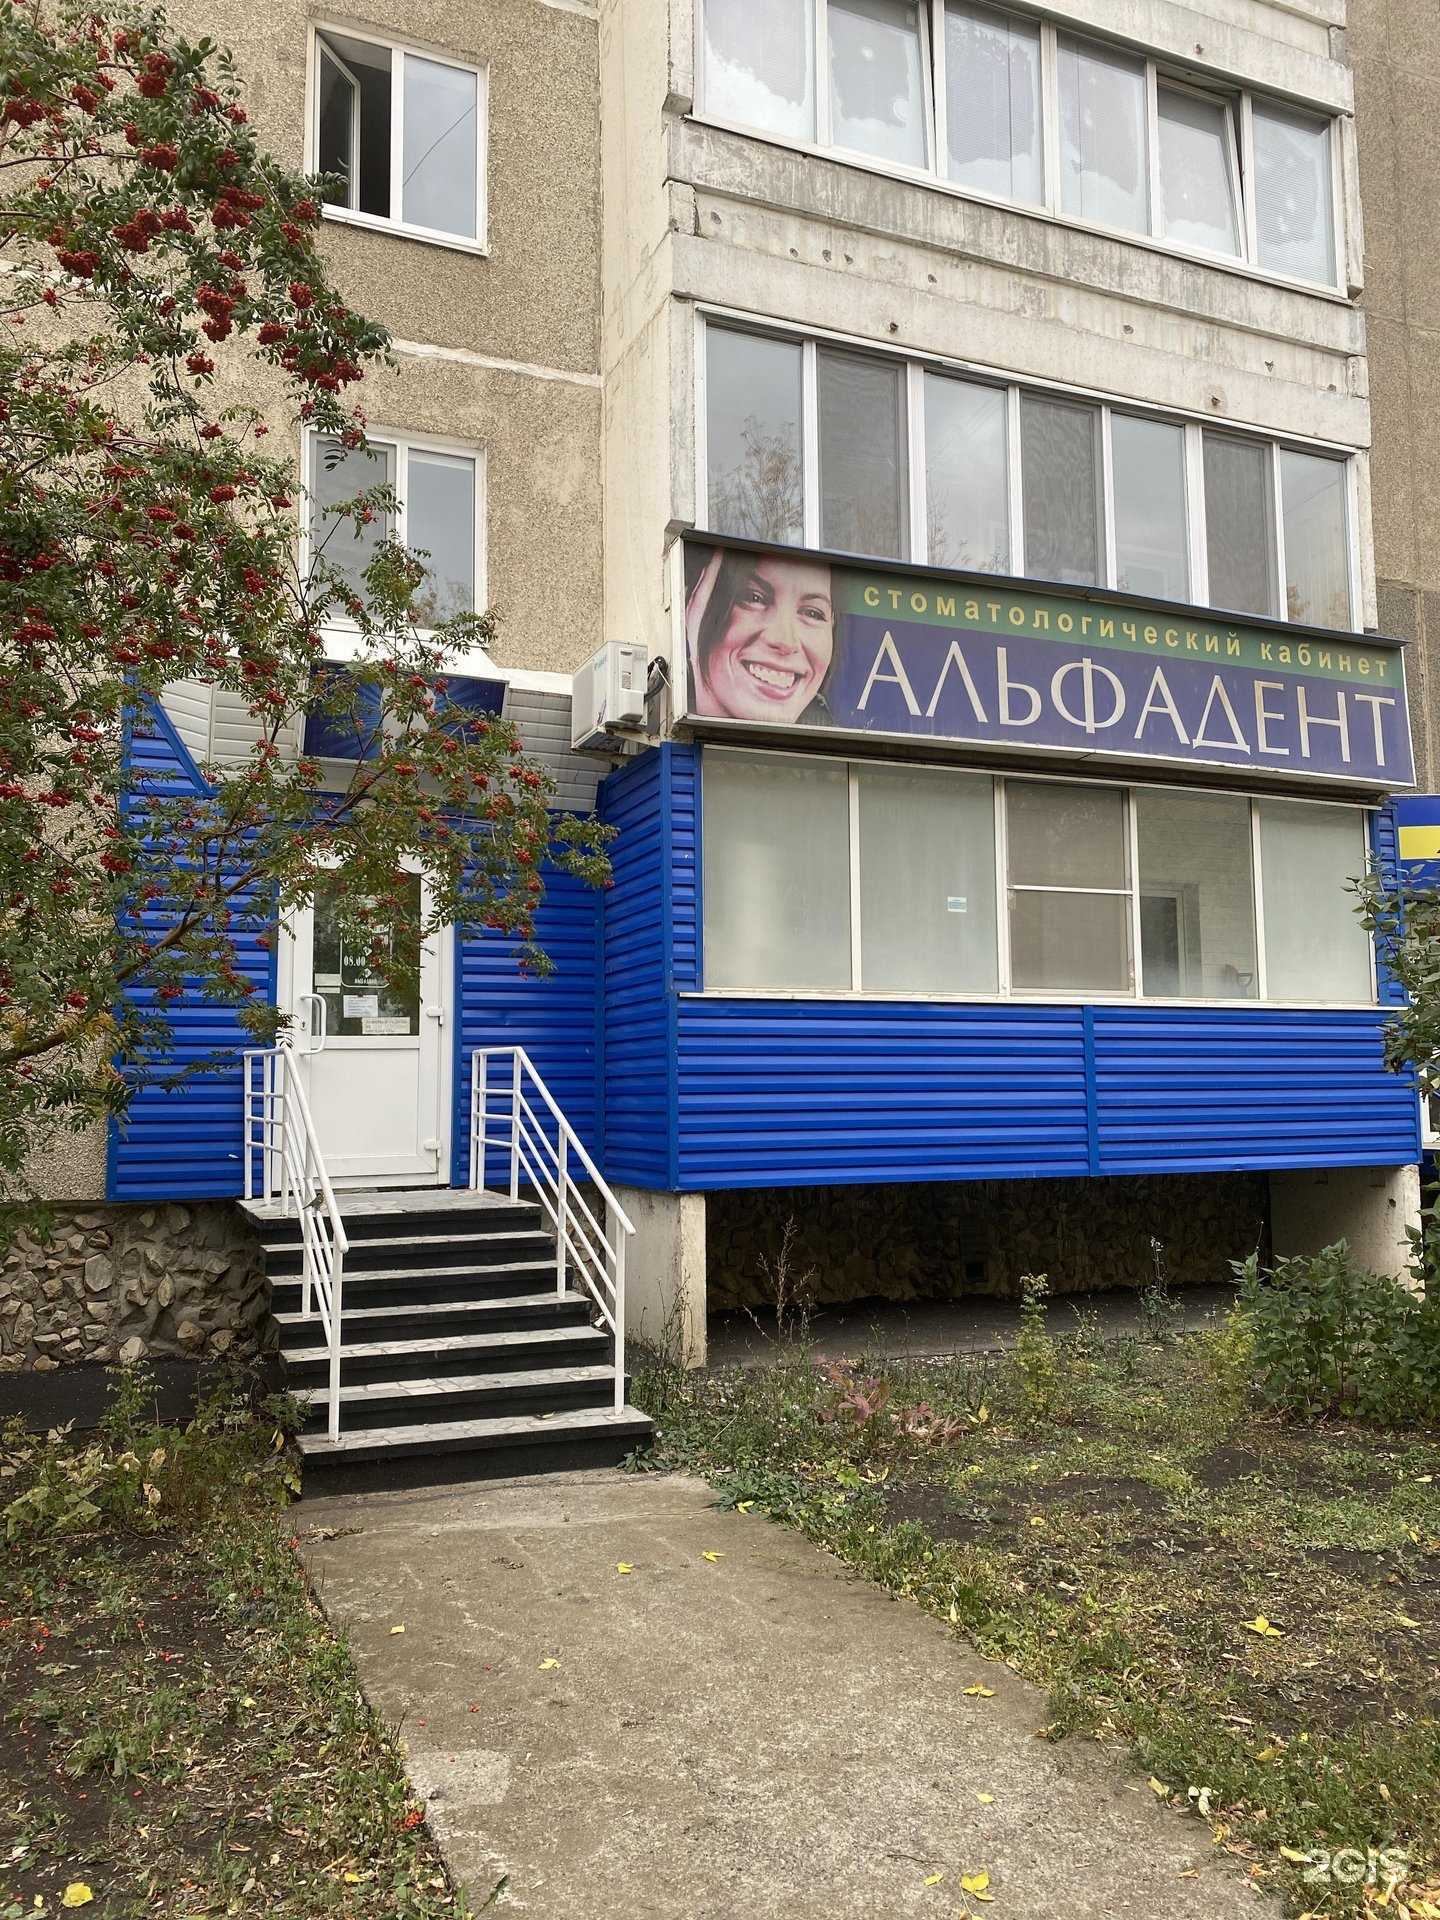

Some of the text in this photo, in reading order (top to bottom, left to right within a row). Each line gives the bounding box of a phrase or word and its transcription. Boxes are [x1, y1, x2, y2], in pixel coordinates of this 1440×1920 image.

[864, 585, 1387, 677] стоматологический кабинет
[856, 629, 1396, 767] АЛЬФАДЕНТ
